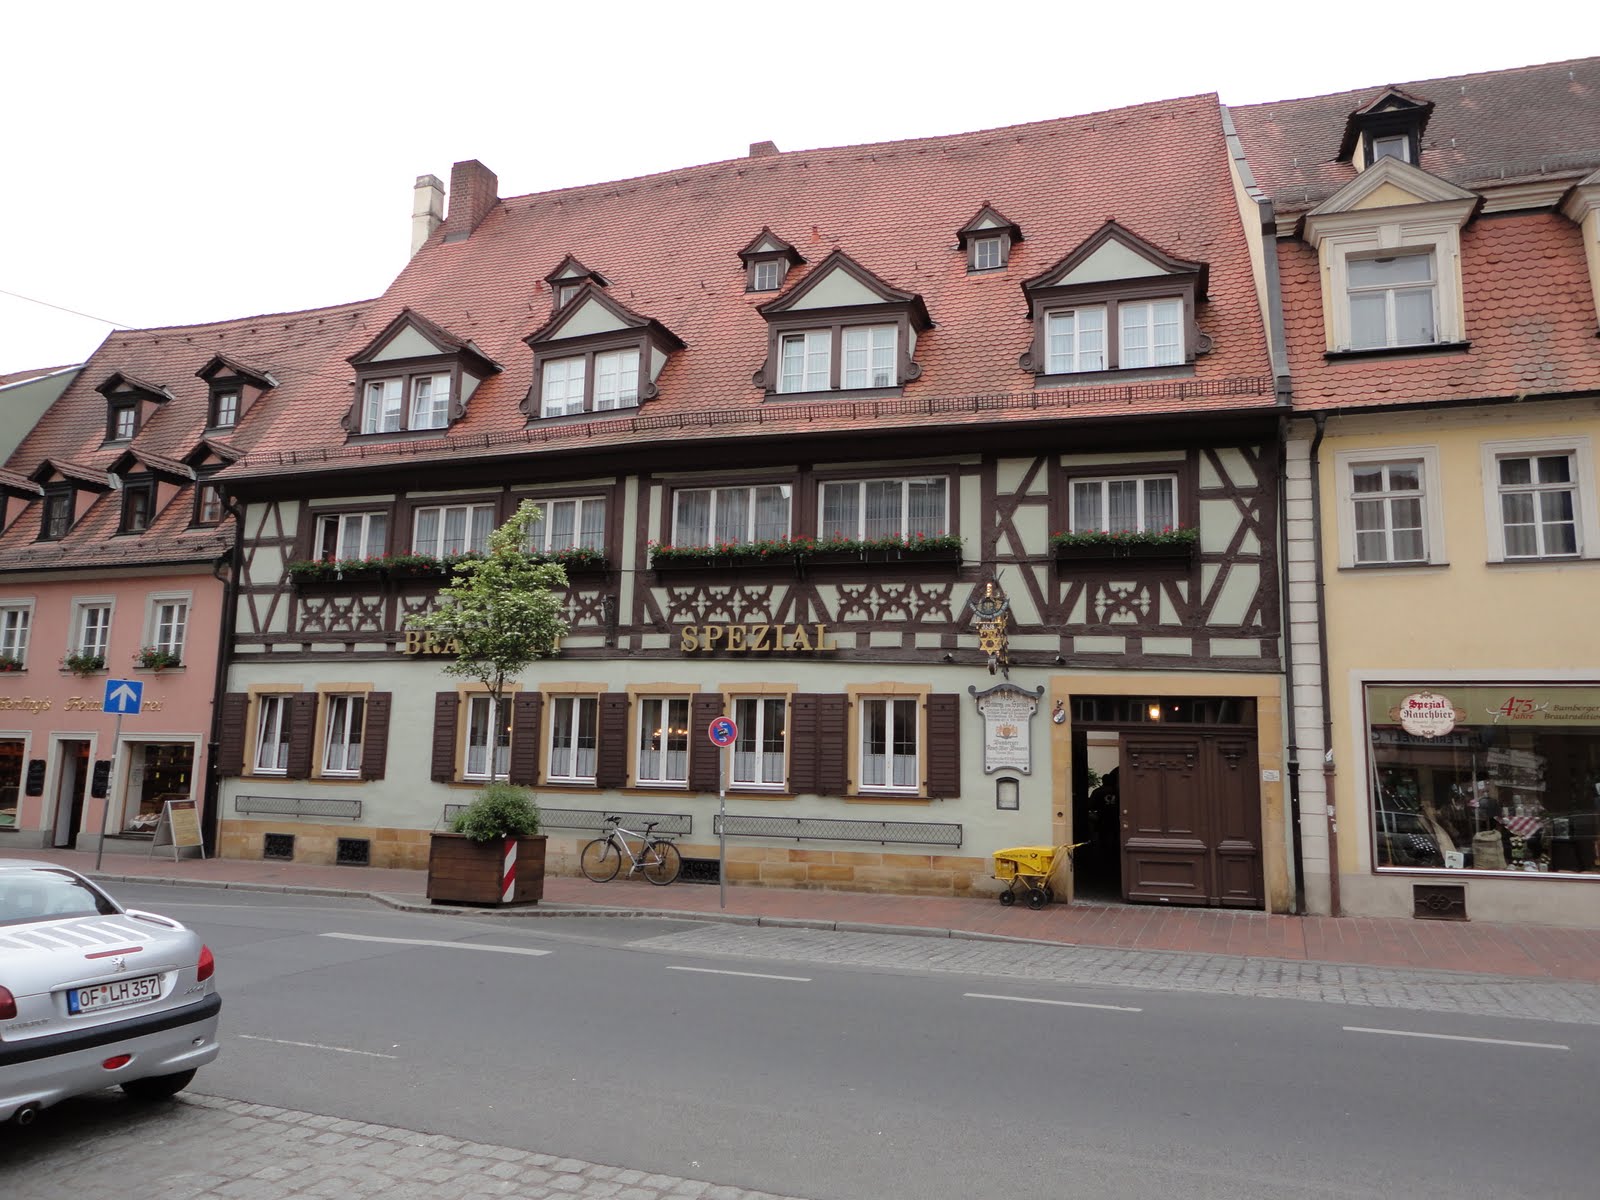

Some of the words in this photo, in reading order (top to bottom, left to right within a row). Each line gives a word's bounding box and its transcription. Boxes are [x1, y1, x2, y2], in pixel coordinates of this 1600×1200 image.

[681, 624, 837, 651] SPEZIAL
[1409, 699, 1445, 710] Spezial
[1500, 696, 1536, 716] 475
[1403, 710, 1453, 720] Rauchbier
[80, 988, 99, 1007] OF
[110, 983, 129, 1001] LH
[132, 978, 156, 998] 357
